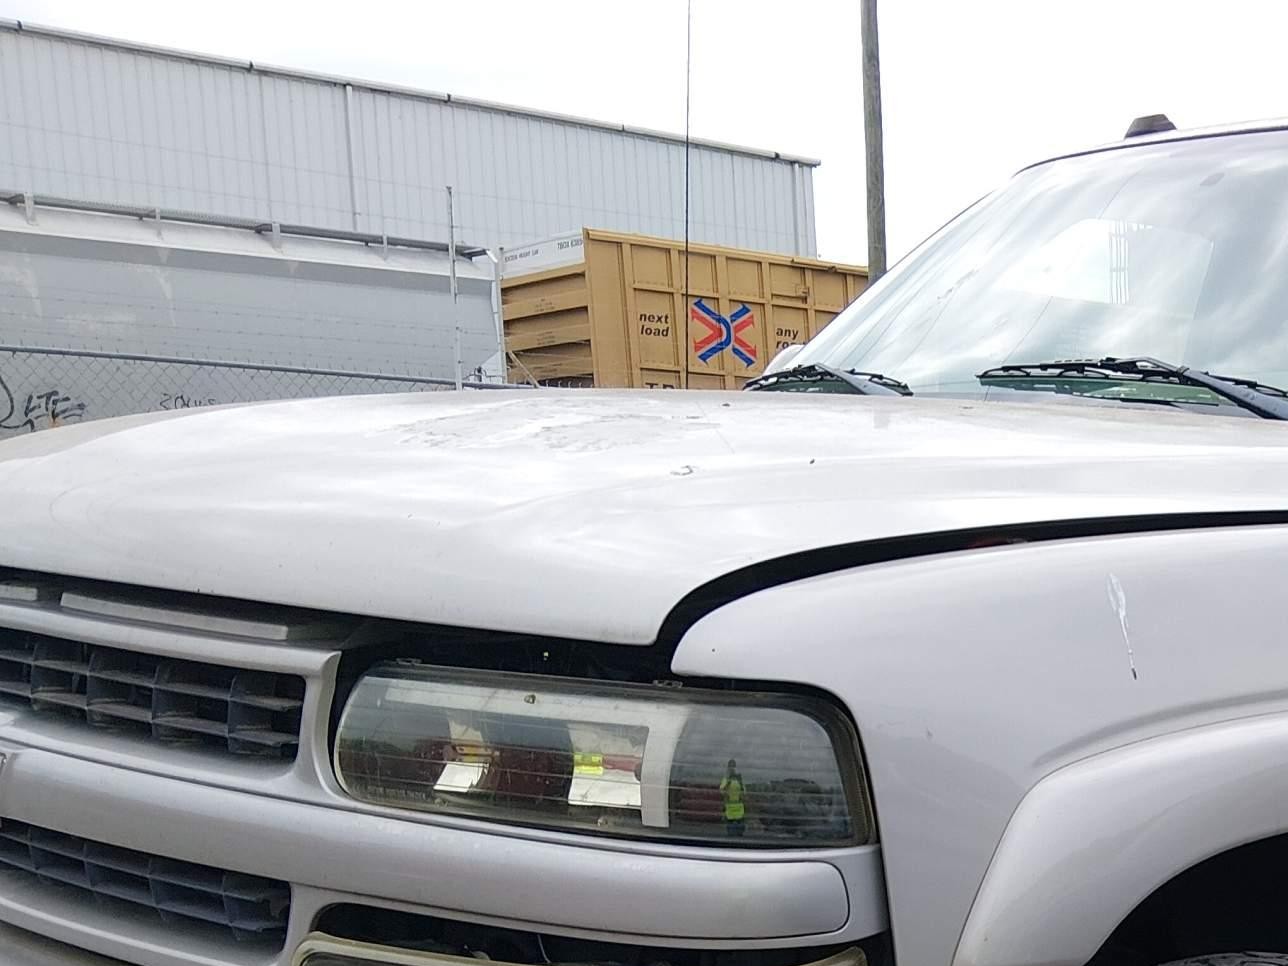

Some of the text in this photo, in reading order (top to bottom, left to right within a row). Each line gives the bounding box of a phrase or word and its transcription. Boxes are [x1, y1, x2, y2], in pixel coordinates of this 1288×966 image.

[640, 313, 669, 324] next
[641, 325, 669, 337] load
[776, 328, 798, 340] any
